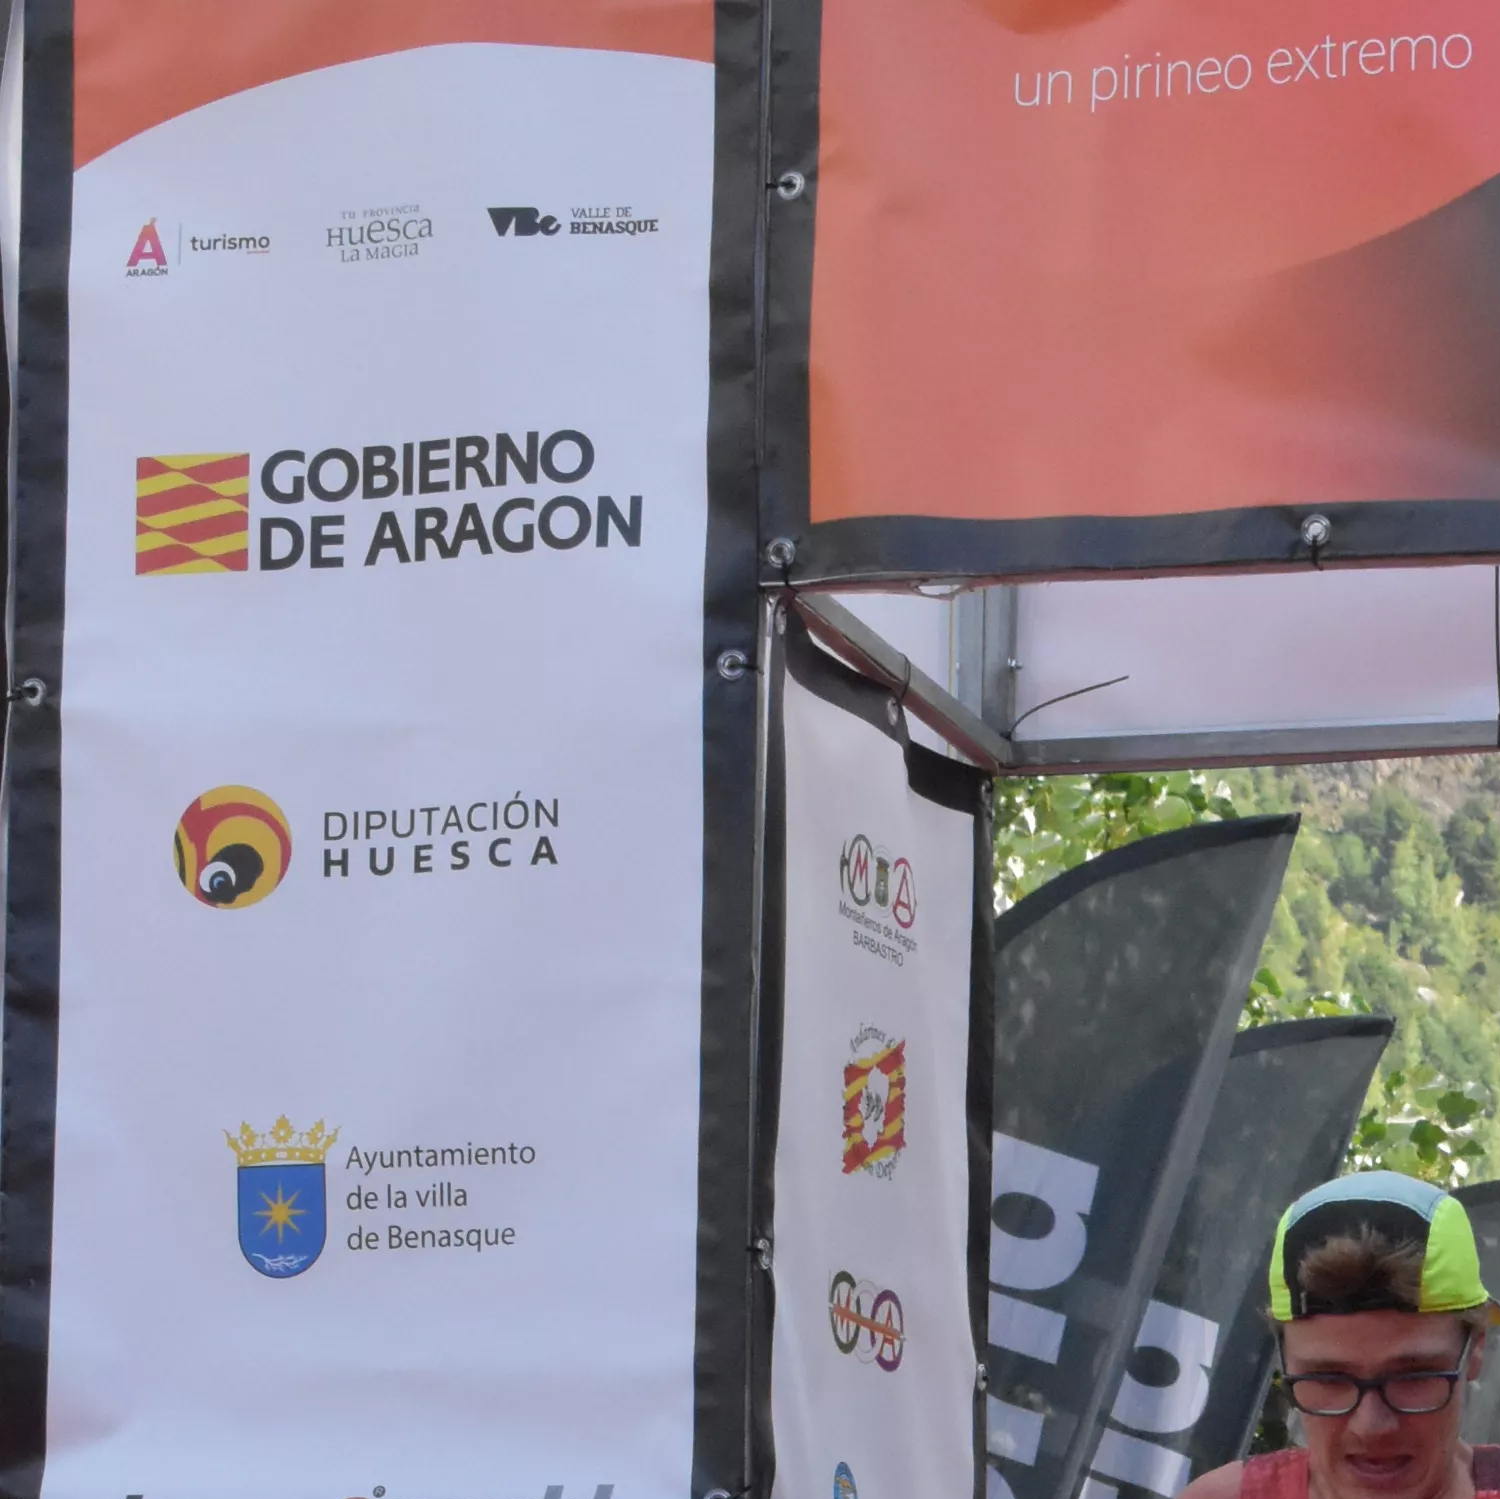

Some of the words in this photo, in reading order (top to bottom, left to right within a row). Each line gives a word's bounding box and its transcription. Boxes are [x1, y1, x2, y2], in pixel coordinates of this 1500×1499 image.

[1012, 66, 1073, 107] un
[1090, 46, 1252, 113] pirineo
[1266, 32, 1473, 85] extremo
[569, 219, 659, 236] BENASQUE
[570, 207, 611, 219] VALLE
[615, 206, 632, 218] DE
[190, 233, 270, 252] turismo
[125, 265, 169, 277] ARAGÓN
[260, 429, 596, 505] GOBIERNO
[259, 515, 346, 572] DE
[364, 494, 644, 567] ARAGON
[322, 790, 560, 841] DIPUTACIÓN
[322, 836, 559, 879] HUESCA
[852, 929, 904, 968] BARBASTRO
[345, 1141, 537, 1173] Ayuntamiento
[345, 1186, 381, 1211] de
[386, 1184, 409, 1209] la
[413, 1181, 469, 1208] villa
[346, 1226, 381, 1251] de
[388, 1223, 516, 1254] Benasque
